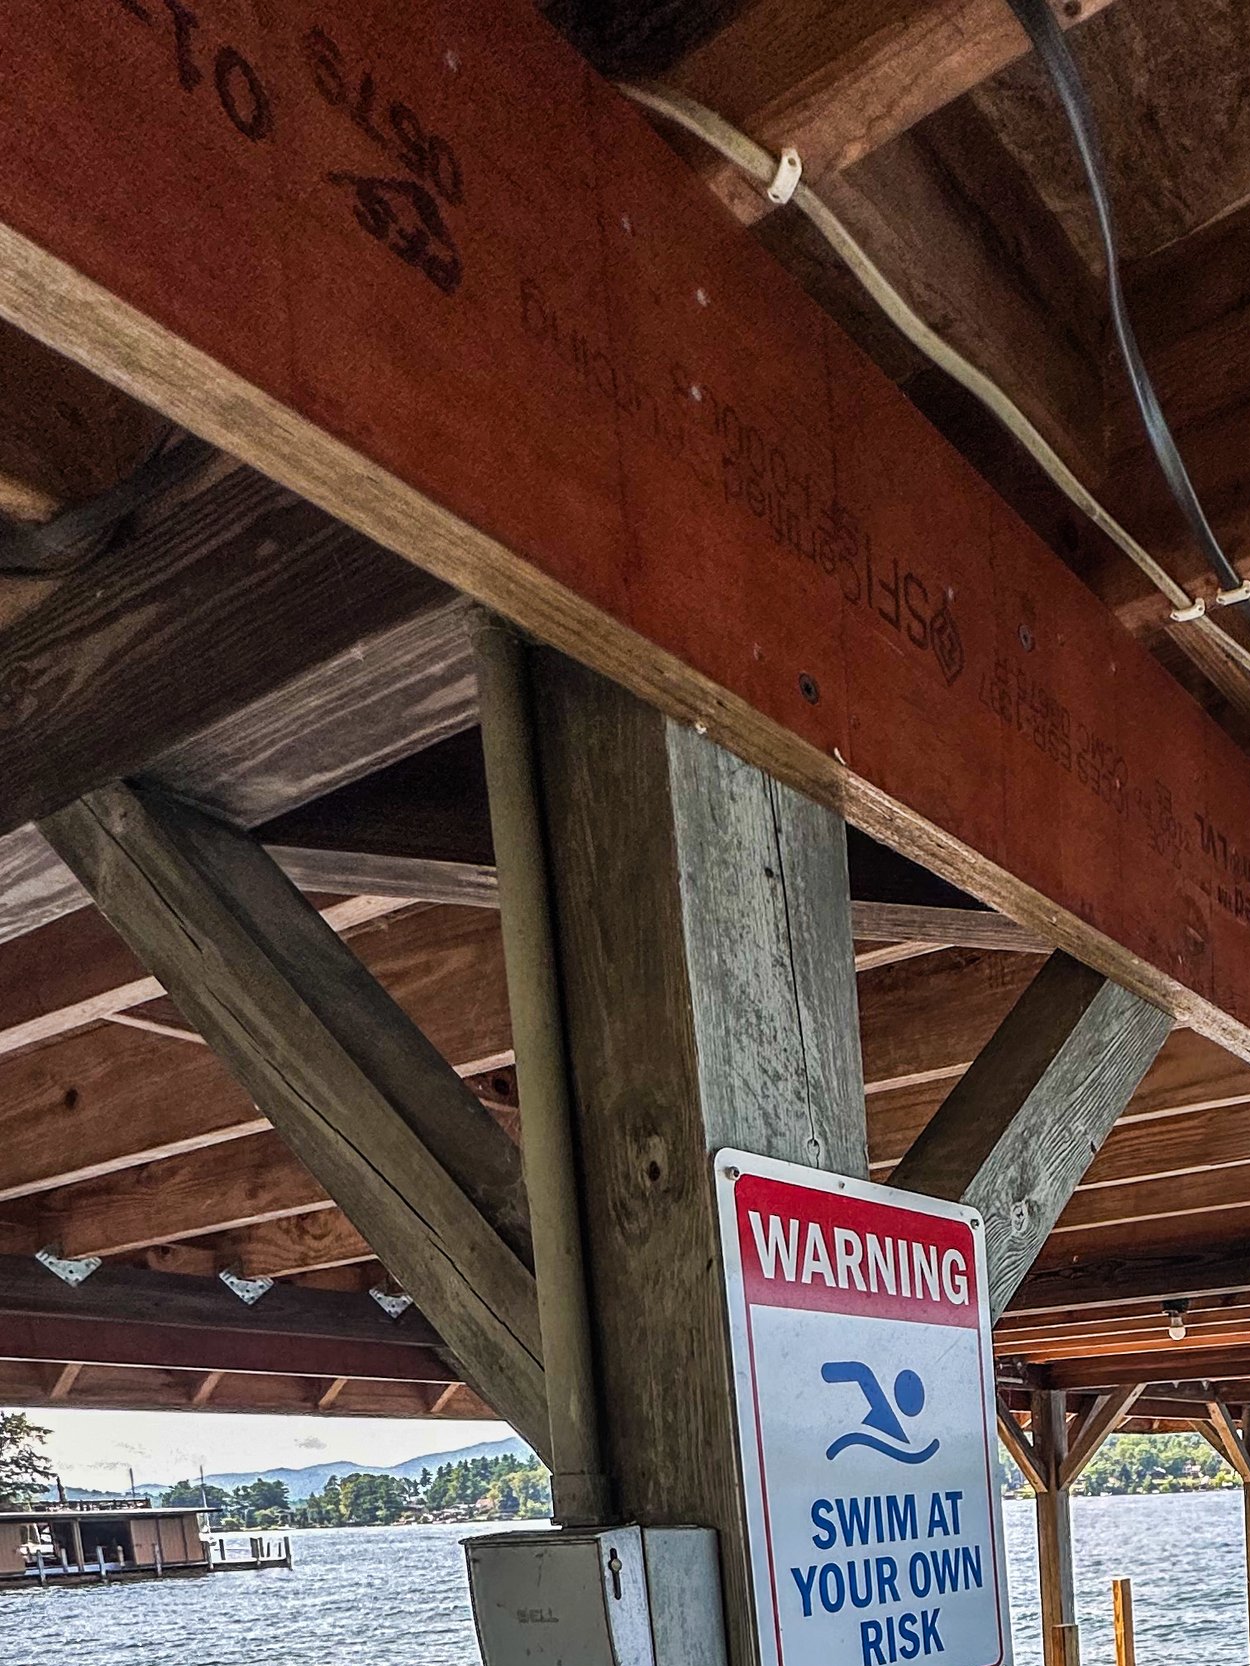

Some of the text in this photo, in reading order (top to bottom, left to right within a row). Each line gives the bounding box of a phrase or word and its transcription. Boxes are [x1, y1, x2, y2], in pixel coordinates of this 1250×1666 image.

[748, 1209, 970, 1305] WARNING
[811, 1491, 963, 1550] SWIM AT
[791, 1545, 983, 1618] YOUR OWN
